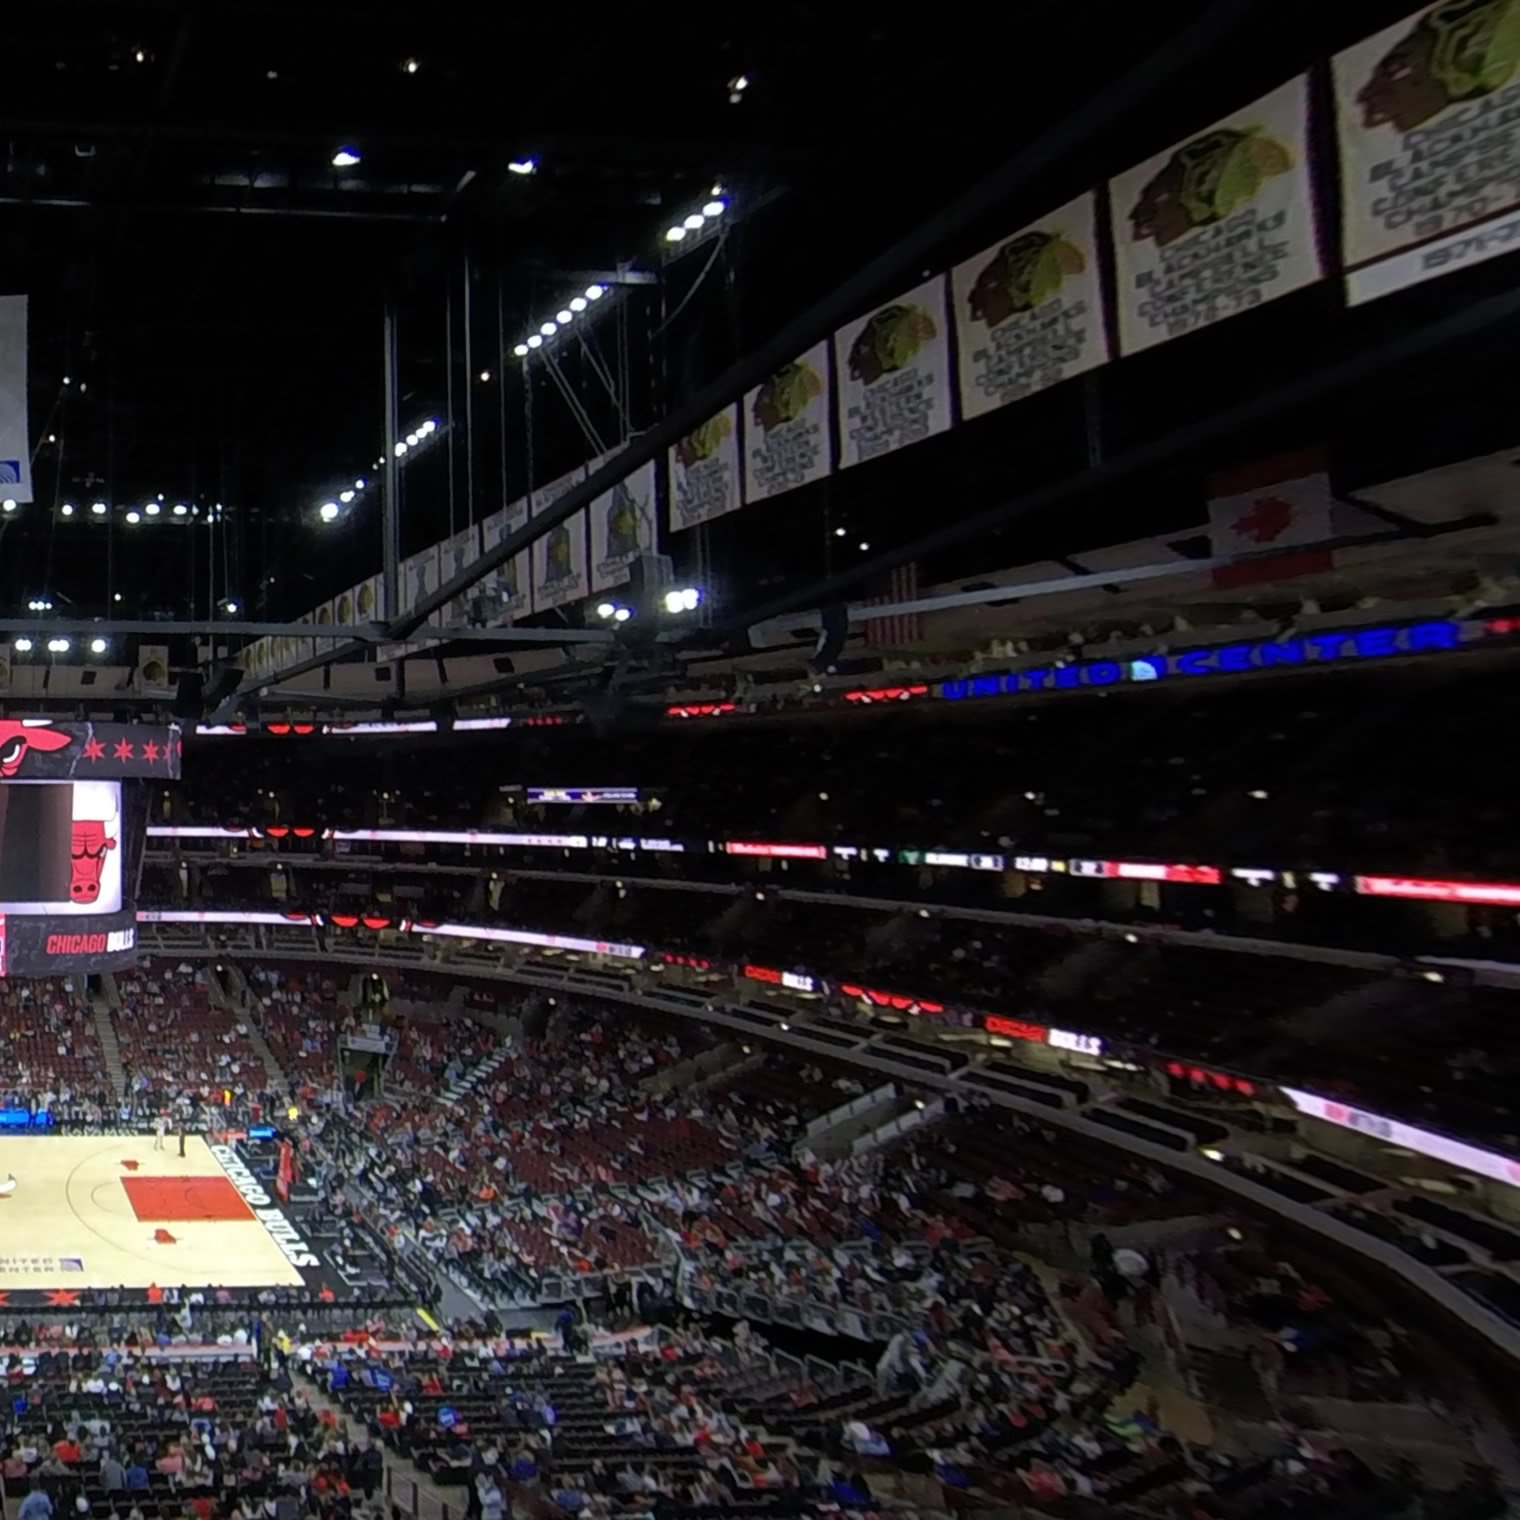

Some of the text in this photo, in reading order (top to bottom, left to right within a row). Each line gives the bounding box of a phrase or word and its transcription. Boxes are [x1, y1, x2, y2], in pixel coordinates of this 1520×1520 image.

[943, 620, 1460, 699] UNITED CENTER
[46, 933, 106, 955] CHICAGO
[211, 1145, 320, 1267] CHICAGO BULLS
